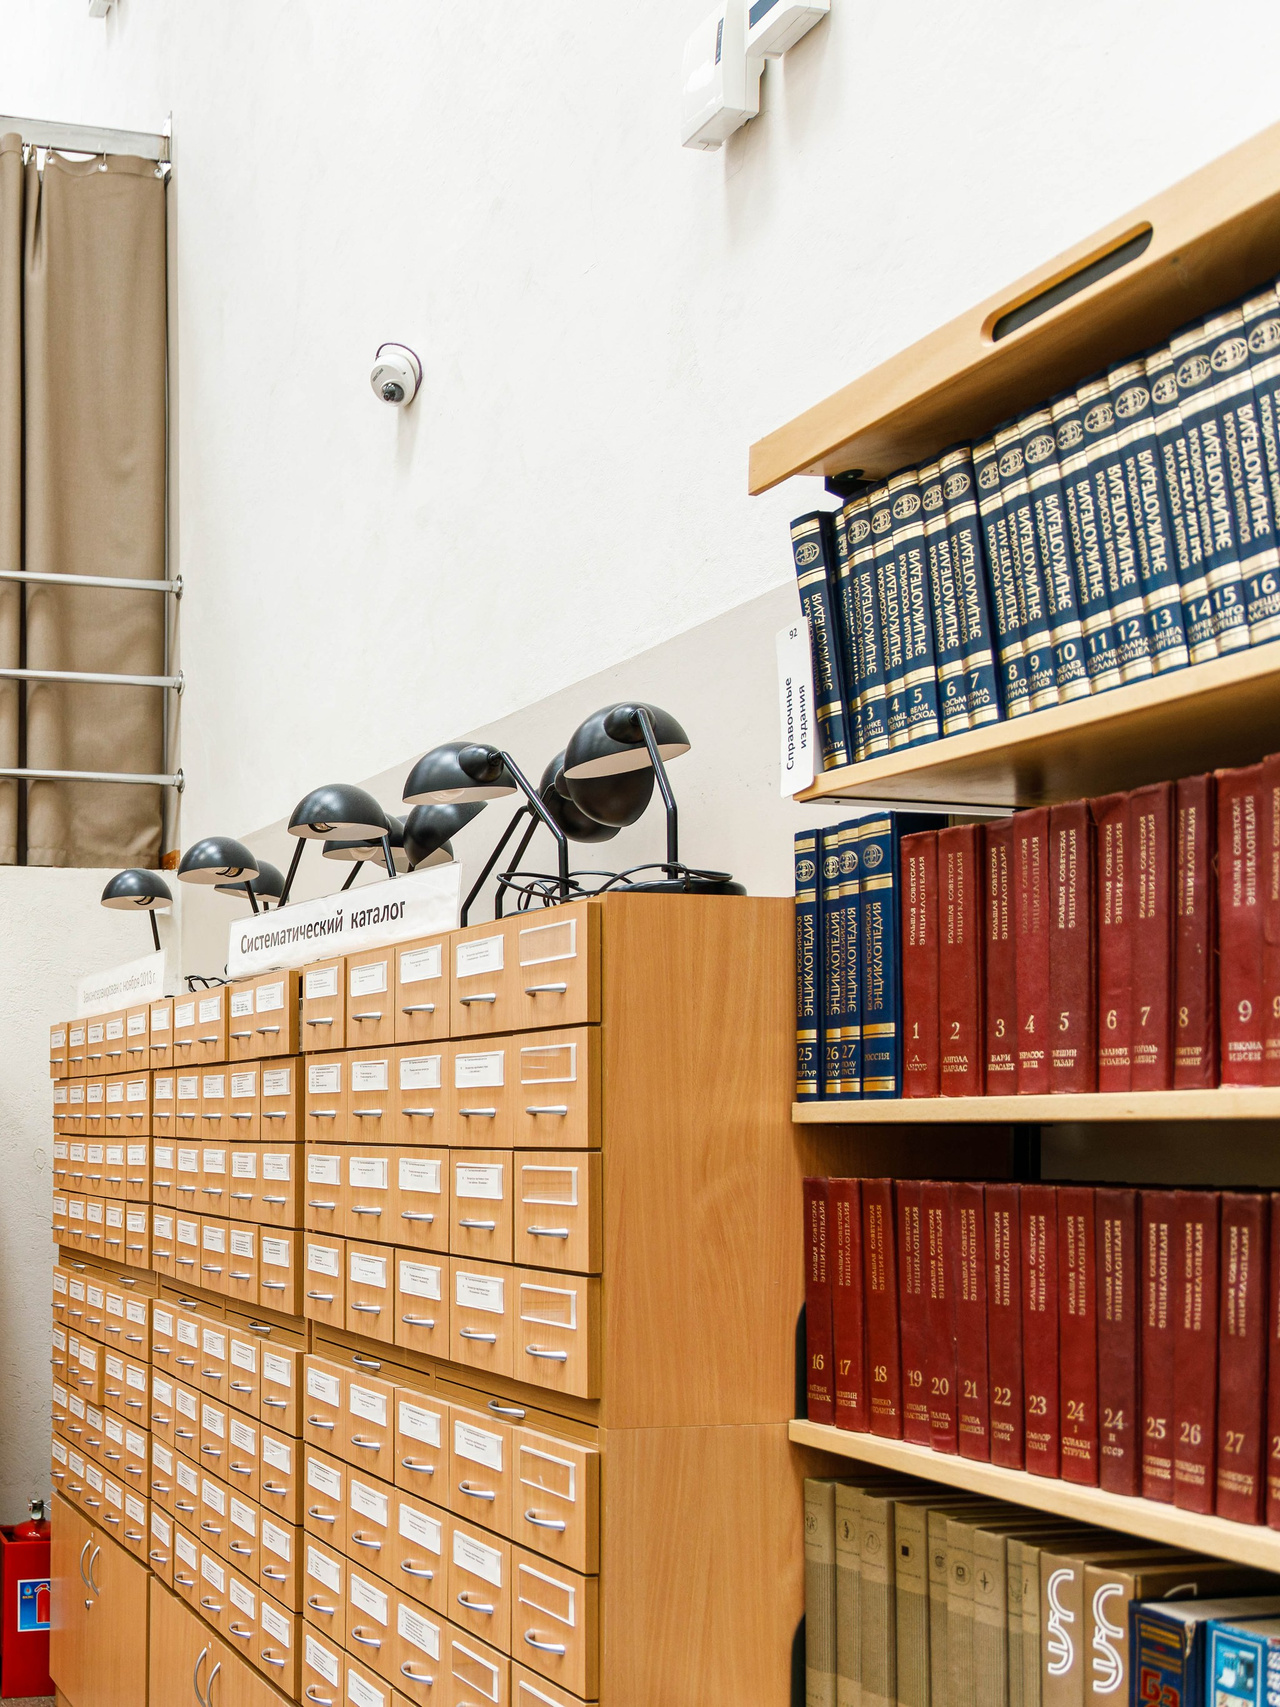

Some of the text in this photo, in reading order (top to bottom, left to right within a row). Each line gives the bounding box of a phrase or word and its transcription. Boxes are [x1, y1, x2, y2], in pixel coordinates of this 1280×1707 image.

[1237, 404, 1270, 538] ЭНЦИКЛОПЕДИЯ
[1201, 420, 1232, 551] ЭНЦИКЛОПЕДИЯ
[1138, 450, 1168, 574] ЭНЦИКЛОПЕДИЯ
[1107, 464, 1136, 586] ЭНЦИКЛОПЕДИЯ
[1077, 480, 1104, 600] ЭНЦИКЛОПЕДИЯ
[1045, 494, 1071, 611] ЭНЦИКЛОПЕДИЯ
[1018, 506, 1042, 621] ЭНЦИКЛОПЕДИЯ
[938, 540, 959, 649] ЭНЦИКЛОПЕДИЯ
[960, 529, 981, 639] ЭНЦИКЛОПЕДИЯ
[1251, 573, 1276, 598] 16
[908, 549, 926, 656] ЭНЦИКЛОПЕДИЯ
[1213, 586, 1236, 609] 15
[886, 562, 902, 667] ЭНЦИКЛОПЕДИЯ
[1151, 609, 1172, 630] 13
[1189, 599, 1211, 621] 14
[789, 628, 798, 639] 92
[860, 572, 877, 675] ЭНЦИКЛОПЕДИЯ
[1119, 620, 1141, 641] 12
[812, 592, 833, 691] ЭНЦИКЛОПЕДИЯ
[1089, 633, 1107, 653] 11
[1030, 655, 1039, 672] 9
[1056, 643, 1076, 664] 10
[971, 673, 979, 688] 7
[1009, 664, 1017, 680] 8
[914, 688, 922, 703] 5
[947, 681, 956, 696] 6
[867, 706, 874, 721] 3
[891, 698, 899, 712] 4
[785, 677, 794, 770] Справочные
[799, 685, 807, 749] издания
[854, 715, 862, 729] 2
[824, 722, 830, 735] 1
[1000, 845, 1008, 940] ЭНЦИКЛОПЕДИЯ
[241, 901, 406, 954] Систематический каталог
[804, 915, 814, 1017] ЭНЦИКЛОПЕДИЯ
[831, 912, 840, 1015] ЭНЦИКЛОПЕДИЯ
[847, 907, 857, 1012] ЭНЦИКЛОПЕДИЯ
[873, 902, 883, 1010] ЭНЦИКЛОПЕДИЯ
[1060, 1012, 1069, 1031] 5
[1107, 1010, 1117, 1029] 6
[1140, 1006, 1151, 1026] 7
[1179, 1007, 1188, 1028] 8
[1238, 1000, 1252, 1022] 9
[913, 1022, 919, 1039] 1
[950, 1022, 960, 1039] 2
[996, 1019, 1005, 1038] 3
[1025, 1015, 1035, 1033] 4
[799, 1047, 812, 1060] 25
[827, 1047, 839, 1060] 26
[842, 1045, 856, 1058] 27
[812, 1354, 824, 1370] 16
[840, 1360, 851, 1375] 17
[874, 1366, 887, 1382] 18
[909, 1370, 922, 1387] 19
[932, 1377, 949, 1395] 20
[964, 1380, 978, 1398] 21
[994, 1387, 1011, 1406] 22
[1029, 1395, 1047, 1415] 23
[1067, 1400, 1085, 1422] 24
[1104, 1408, 1124, 1430] 24
[1147, 1417, 1166, 1439] 25
[1180, 1422, 1201, 1445] 26
[1225, 1431, 1245, 1454] 27
